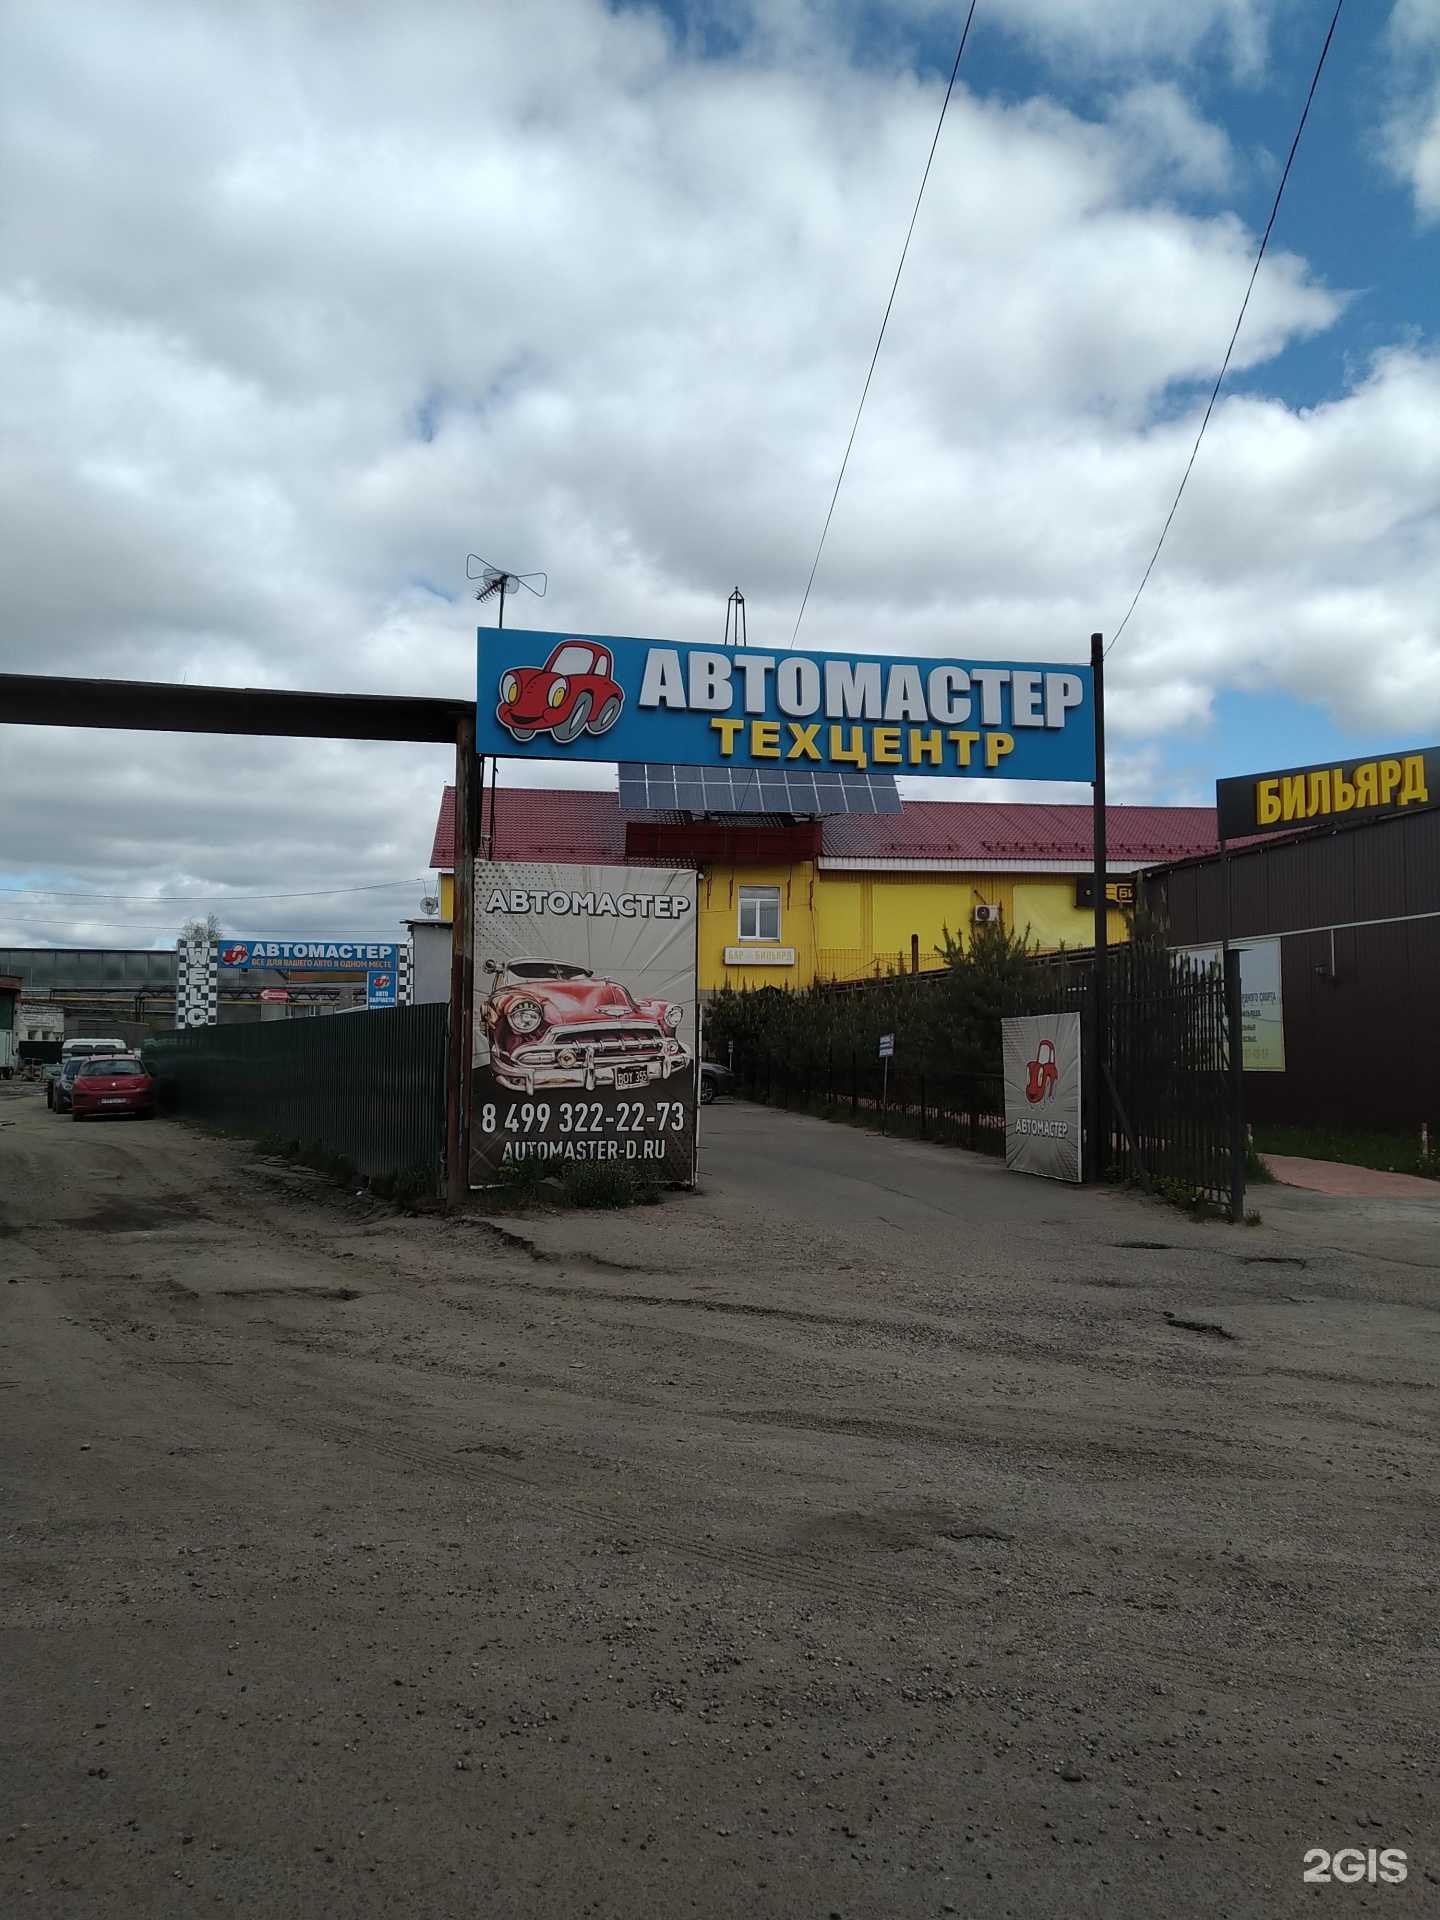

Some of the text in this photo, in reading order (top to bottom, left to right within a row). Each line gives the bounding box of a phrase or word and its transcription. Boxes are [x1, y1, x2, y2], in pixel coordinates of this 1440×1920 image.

[638, 648, 1083, 728] АВТОМАСТЕР
[711, 718, 1014, 768] ТЕХЦЕНТР
[1257, 755, 1428, 825] БИЛЬЯРД
[486, 890, 690, 918] АВТОМАСТЕР
[252, 943, 392, 959] АВТОМАСТЕР
[482, 1102, 684, 1132] 8 499 322-22-73
[1015, 1119, 1069, 1138] АВТОМАСТЕР
[502, 1139, 666, 1161] AUTOMASTER-D.RU
